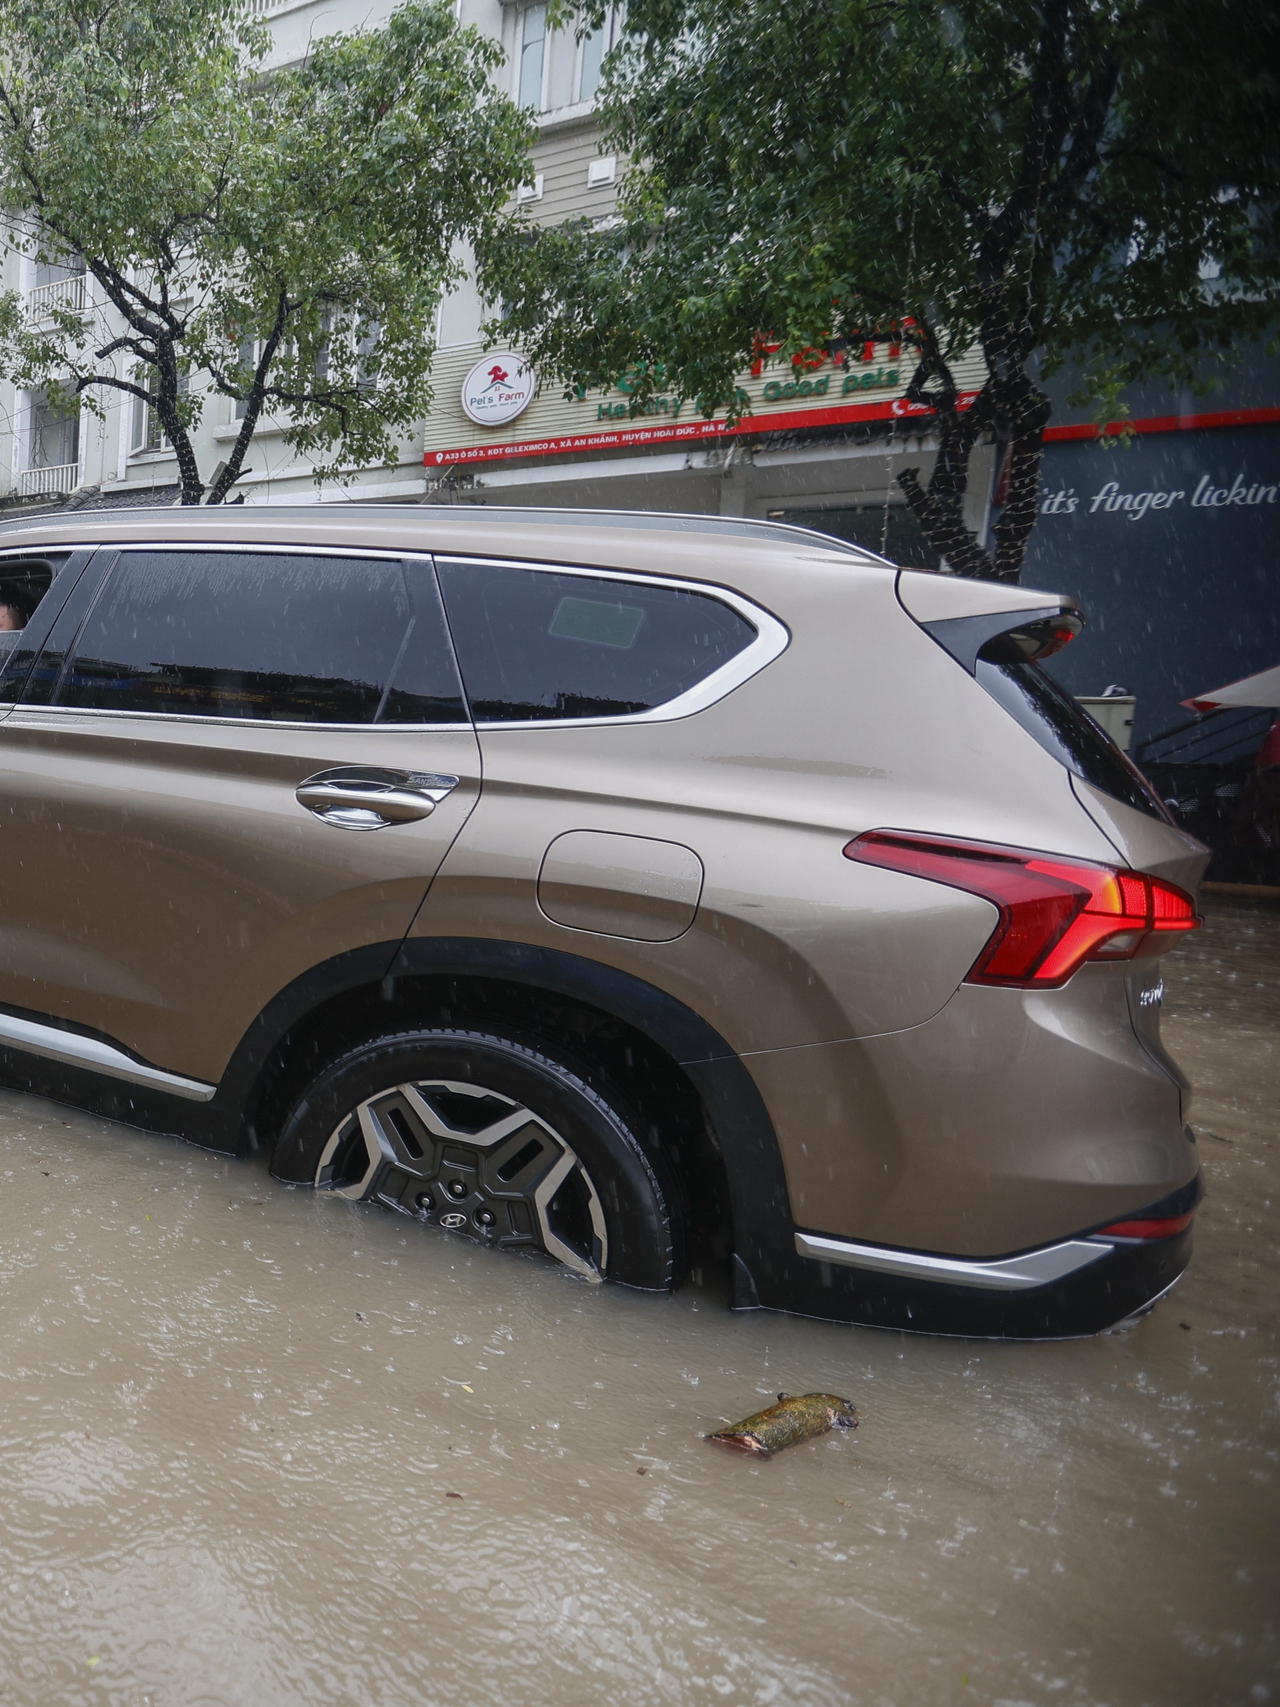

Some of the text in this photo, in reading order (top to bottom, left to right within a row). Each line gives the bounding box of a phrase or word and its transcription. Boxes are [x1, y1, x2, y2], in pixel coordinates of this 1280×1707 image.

[763, 374, 831, 400] Good
[842, 367, 901, 396] pets
[470, 391, 525, 407] Pet's Farm
[505, 443, 549, 453] GELEXIMCO
[549, 442, 558, 450] A,
[560, 438, 572, 448] XÃ
[574, 438, 586, 446] AN
[588, 434, 620, 446] KHÁNH,
[622, 430, 652, 442] HUYỆN
[1089, 481, 1186, 521] finger
